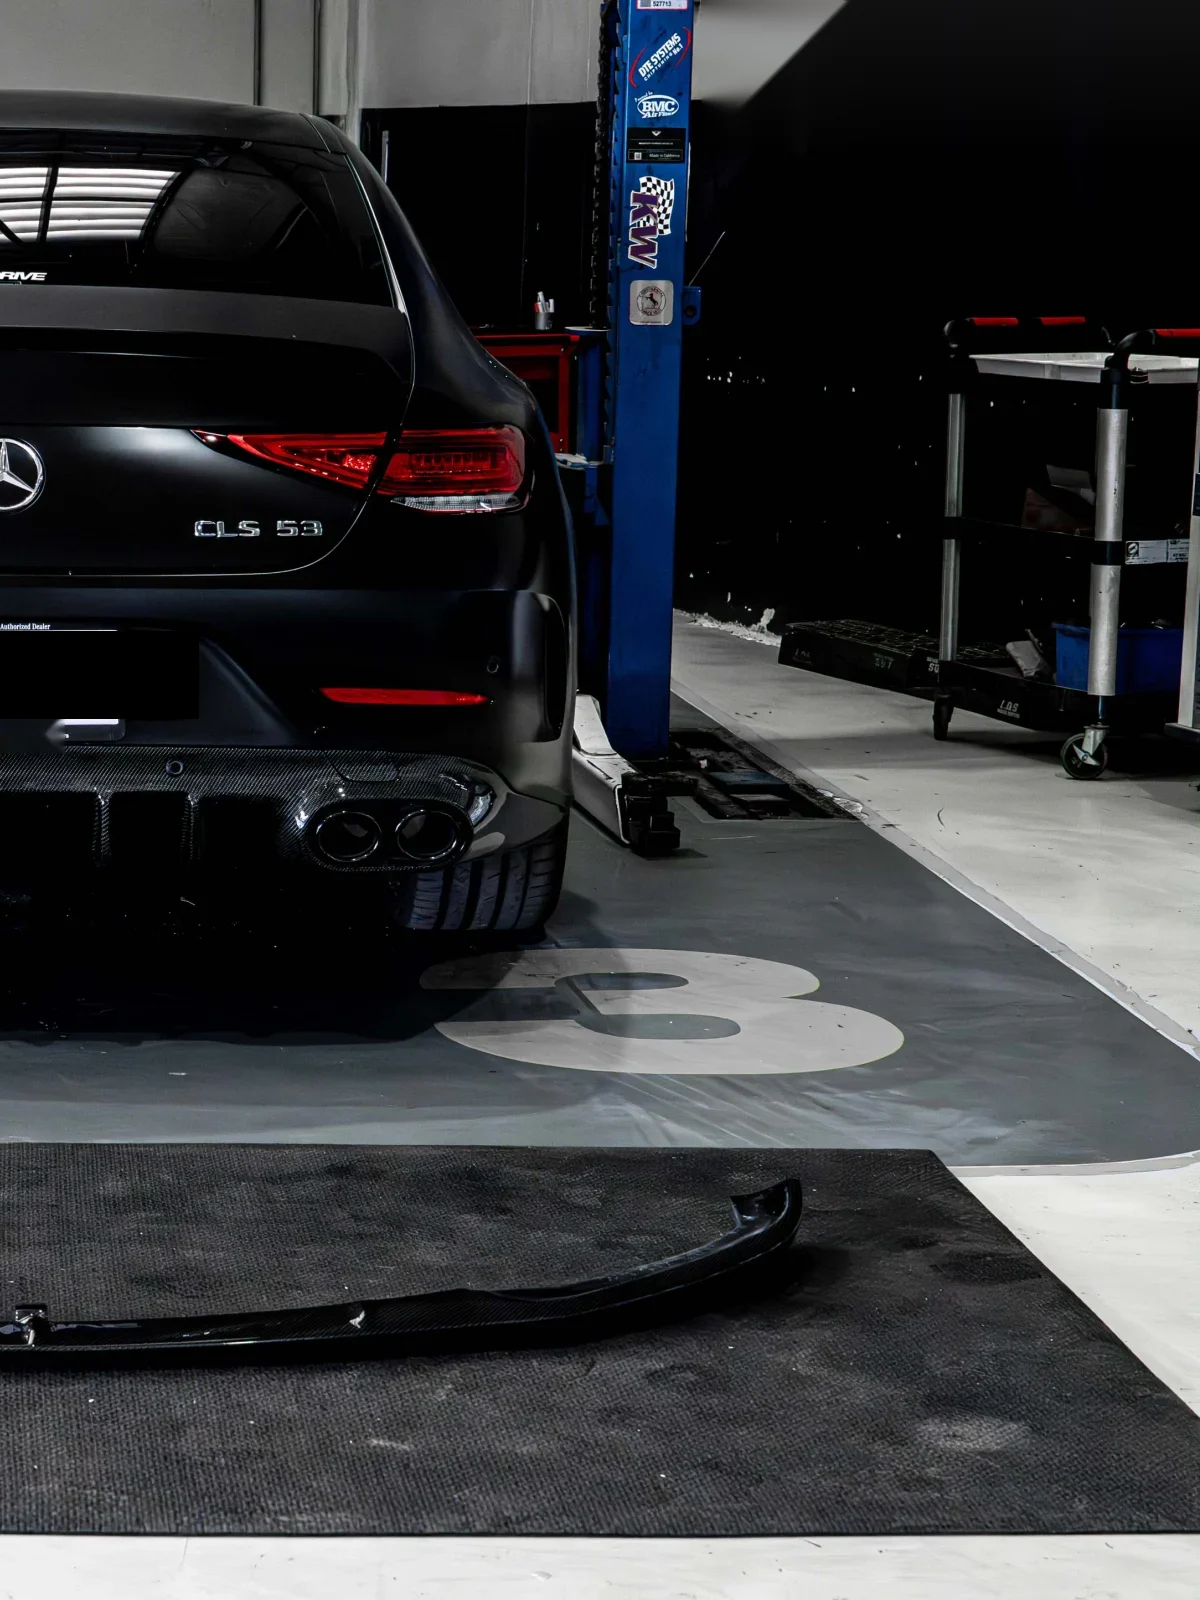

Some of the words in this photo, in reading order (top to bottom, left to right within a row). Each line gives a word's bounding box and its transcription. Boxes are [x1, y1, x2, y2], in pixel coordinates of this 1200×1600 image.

[638, 59, 654, 78] DTE
[650, 32, 681, 66] SYSTEMS
[641, 100, 675, 112] BMC
[627, 190, 658, 270] KW
[194, 520, 260, 538] CLS
[276, 520, 323, 537] 53
[0, 622, 31, 631] Authorized
[31, 622, 51, 631] Dealer
[419, 947, 905, 1075] 3
